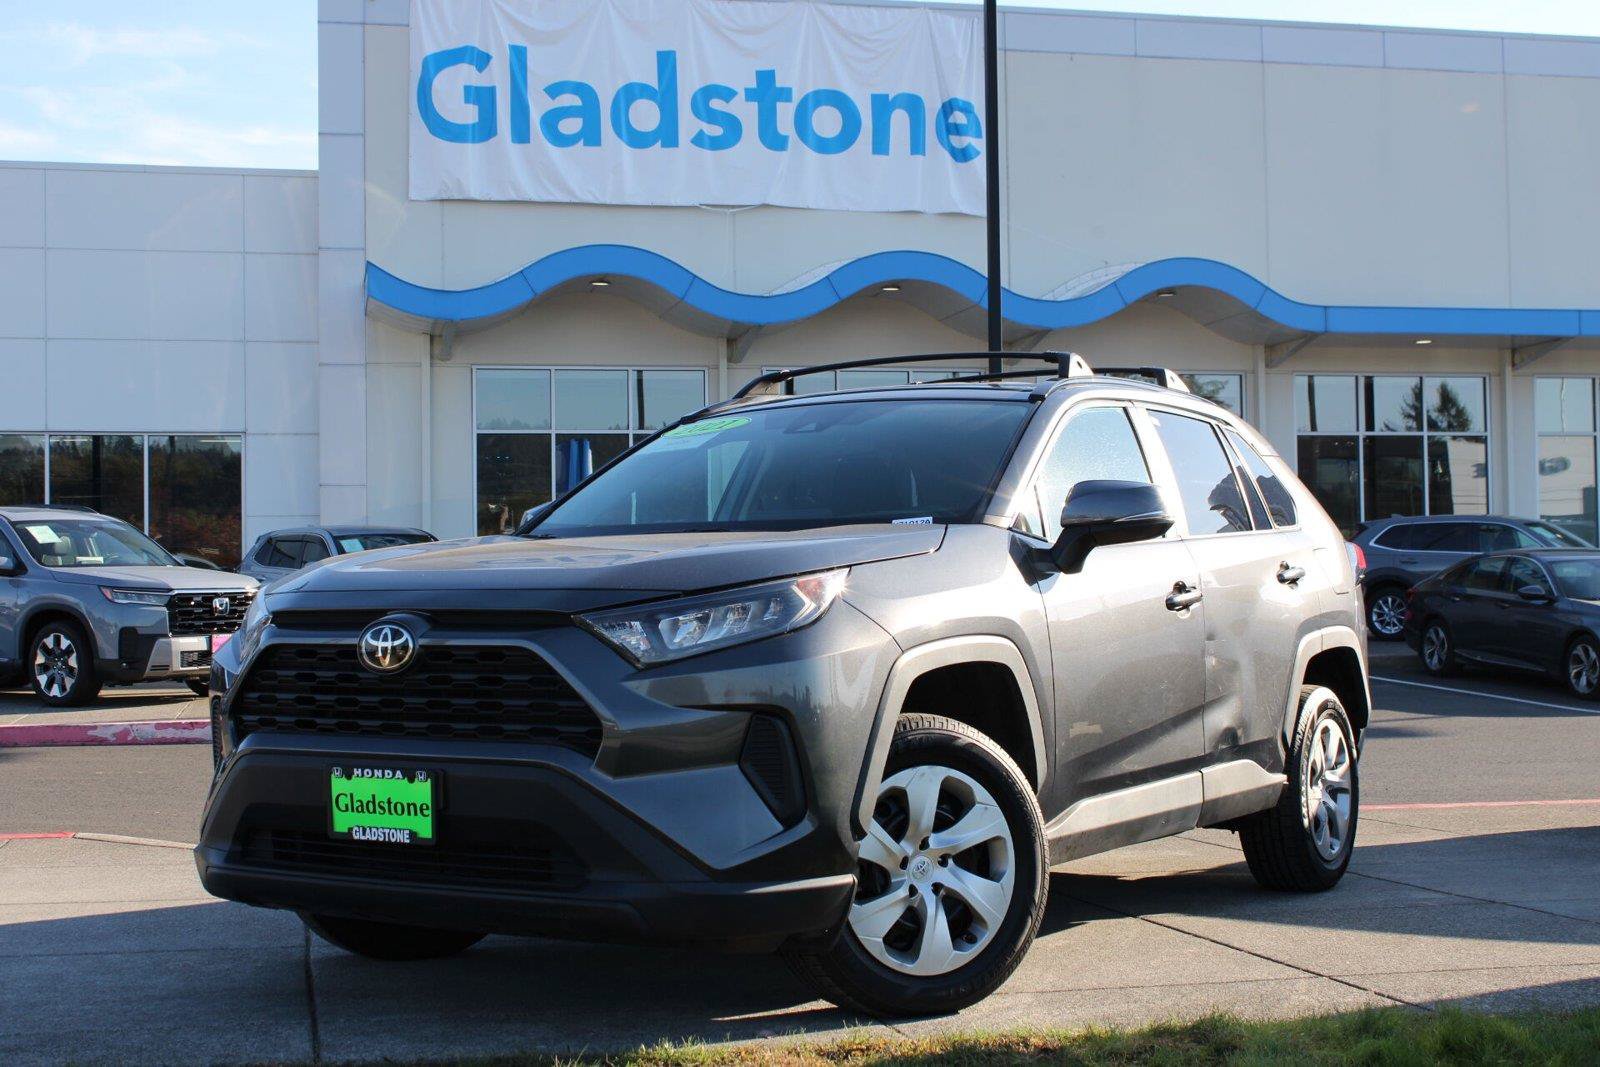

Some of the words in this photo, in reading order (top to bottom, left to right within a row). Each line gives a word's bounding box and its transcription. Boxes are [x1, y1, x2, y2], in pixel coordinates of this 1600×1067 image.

[417, 44, 983, 163] Gladstone
[353, 768, 403, 779] HONDA
[334, 792, 430, 818] Gladstone
[352, 826, 410, 843] GLADSTONE
